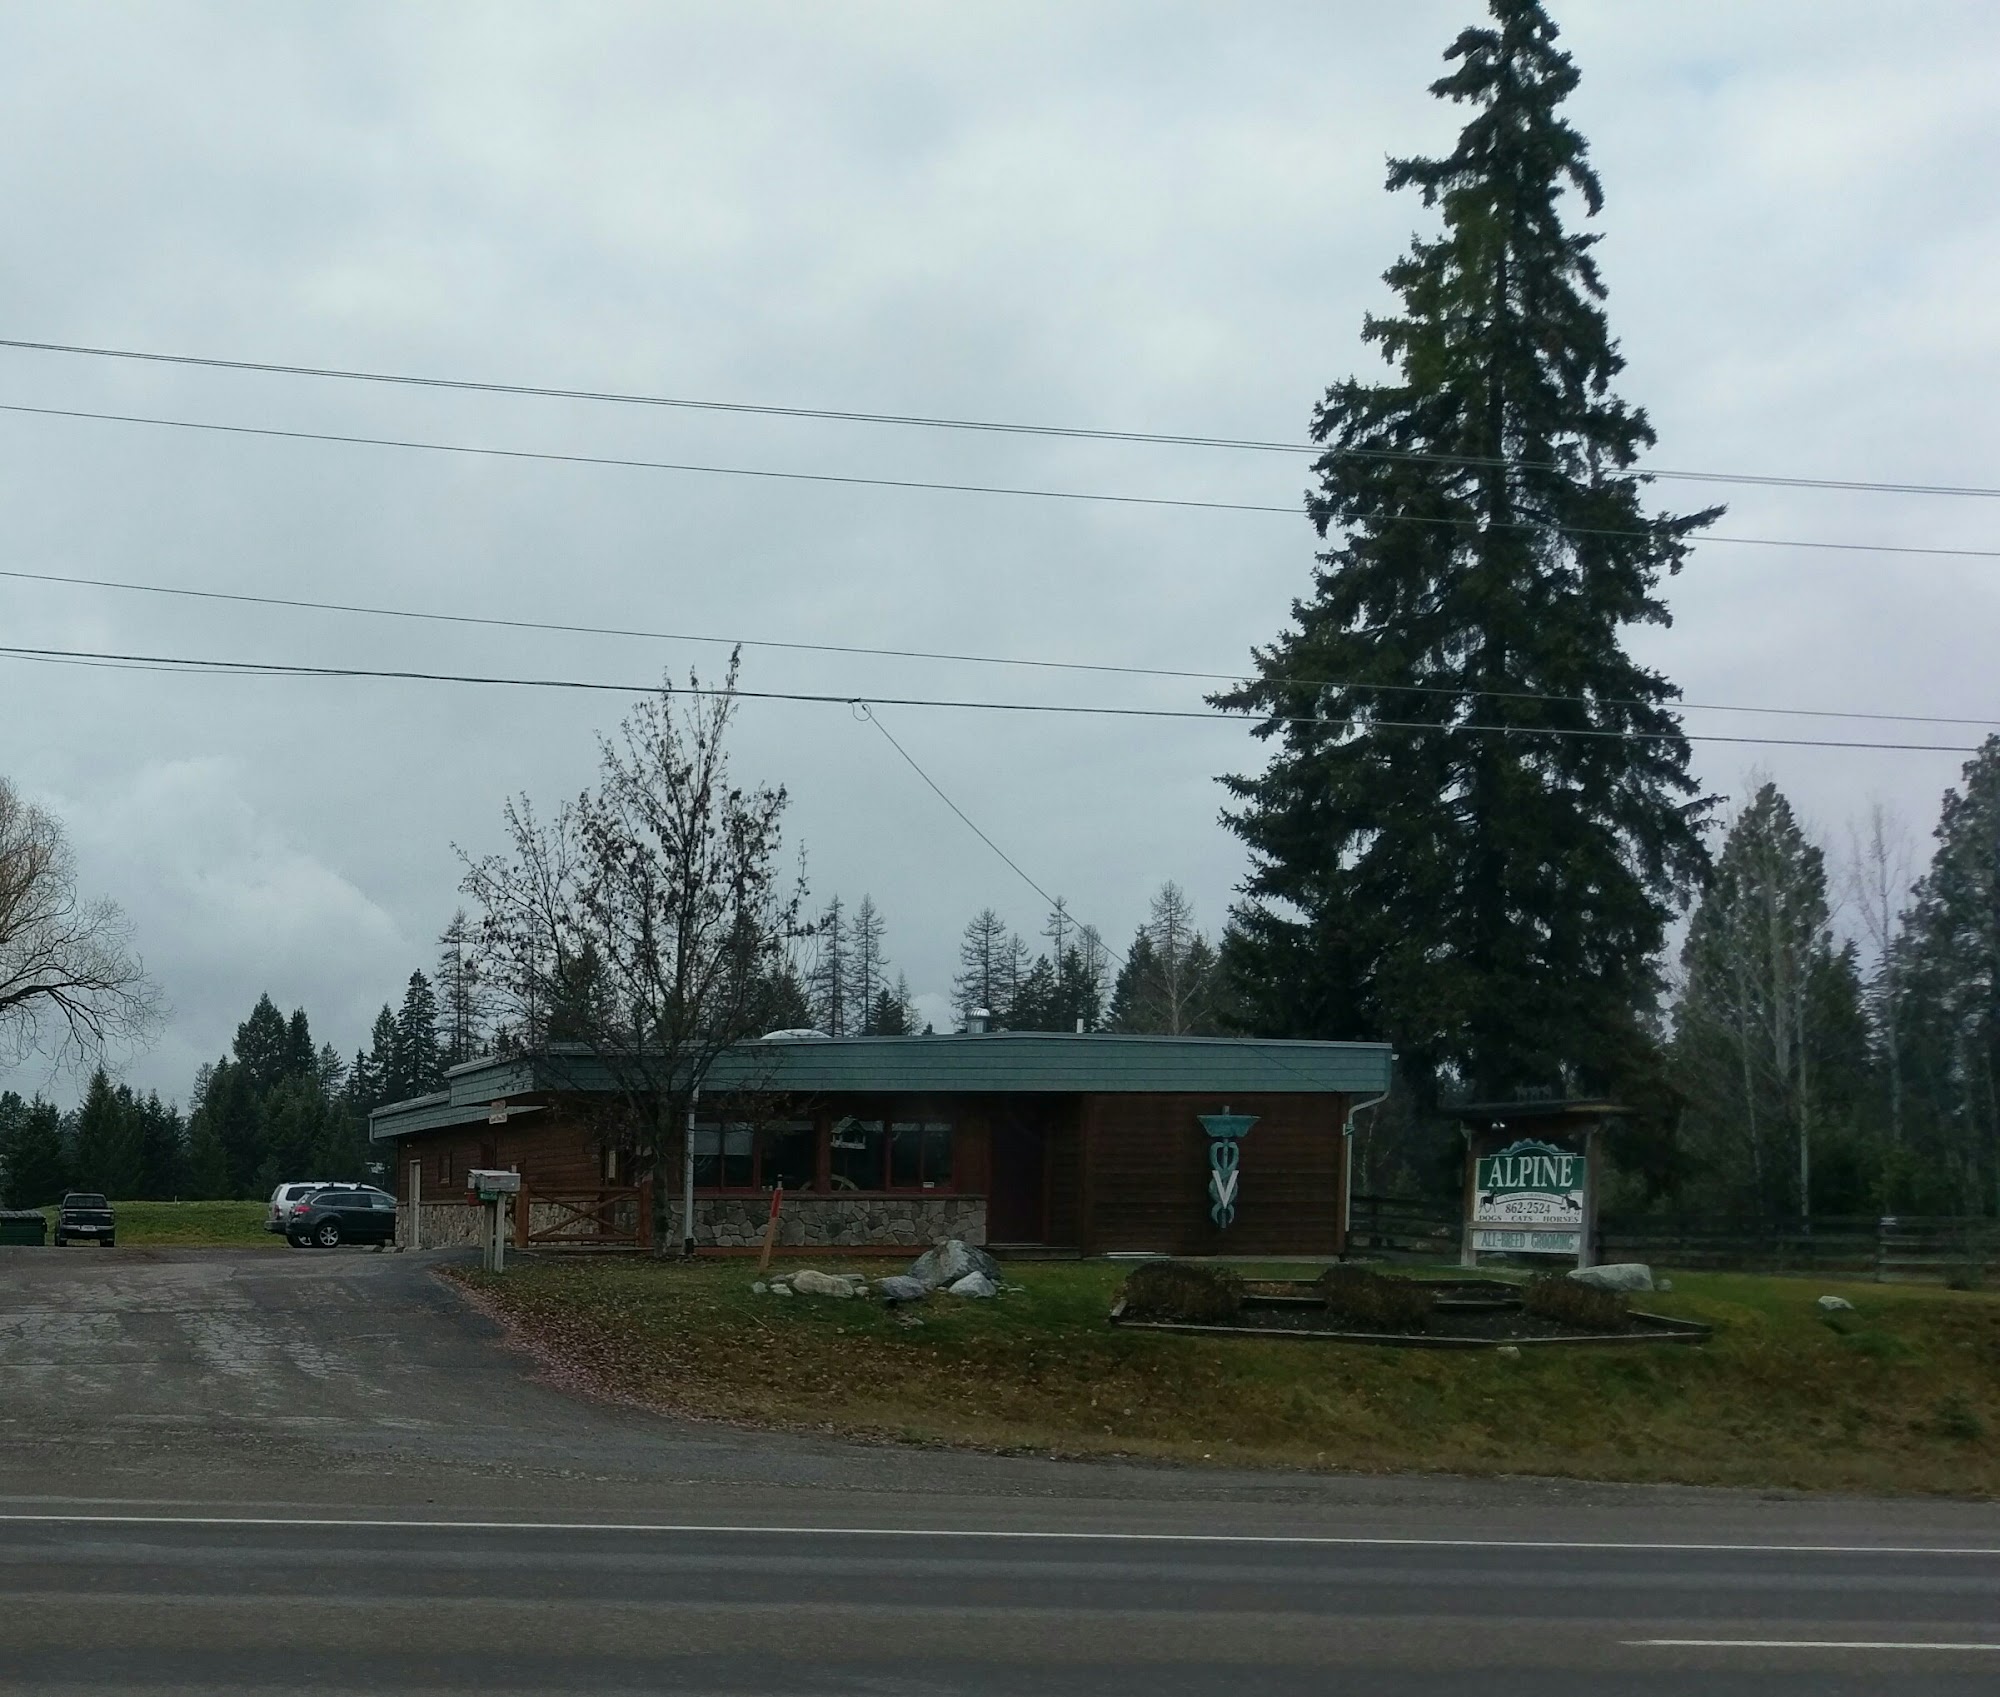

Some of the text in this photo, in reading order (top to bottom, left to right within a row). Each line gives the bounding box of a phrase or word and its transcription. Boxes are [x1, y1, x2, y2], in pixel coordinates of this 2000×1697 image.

[1487, 1156, 1573, 1187] ALPINE
[1505, 1202, 1551, 1214] 862-2524
[1481, 1232, 1574, 1250] ALL-BREED GROOMING
